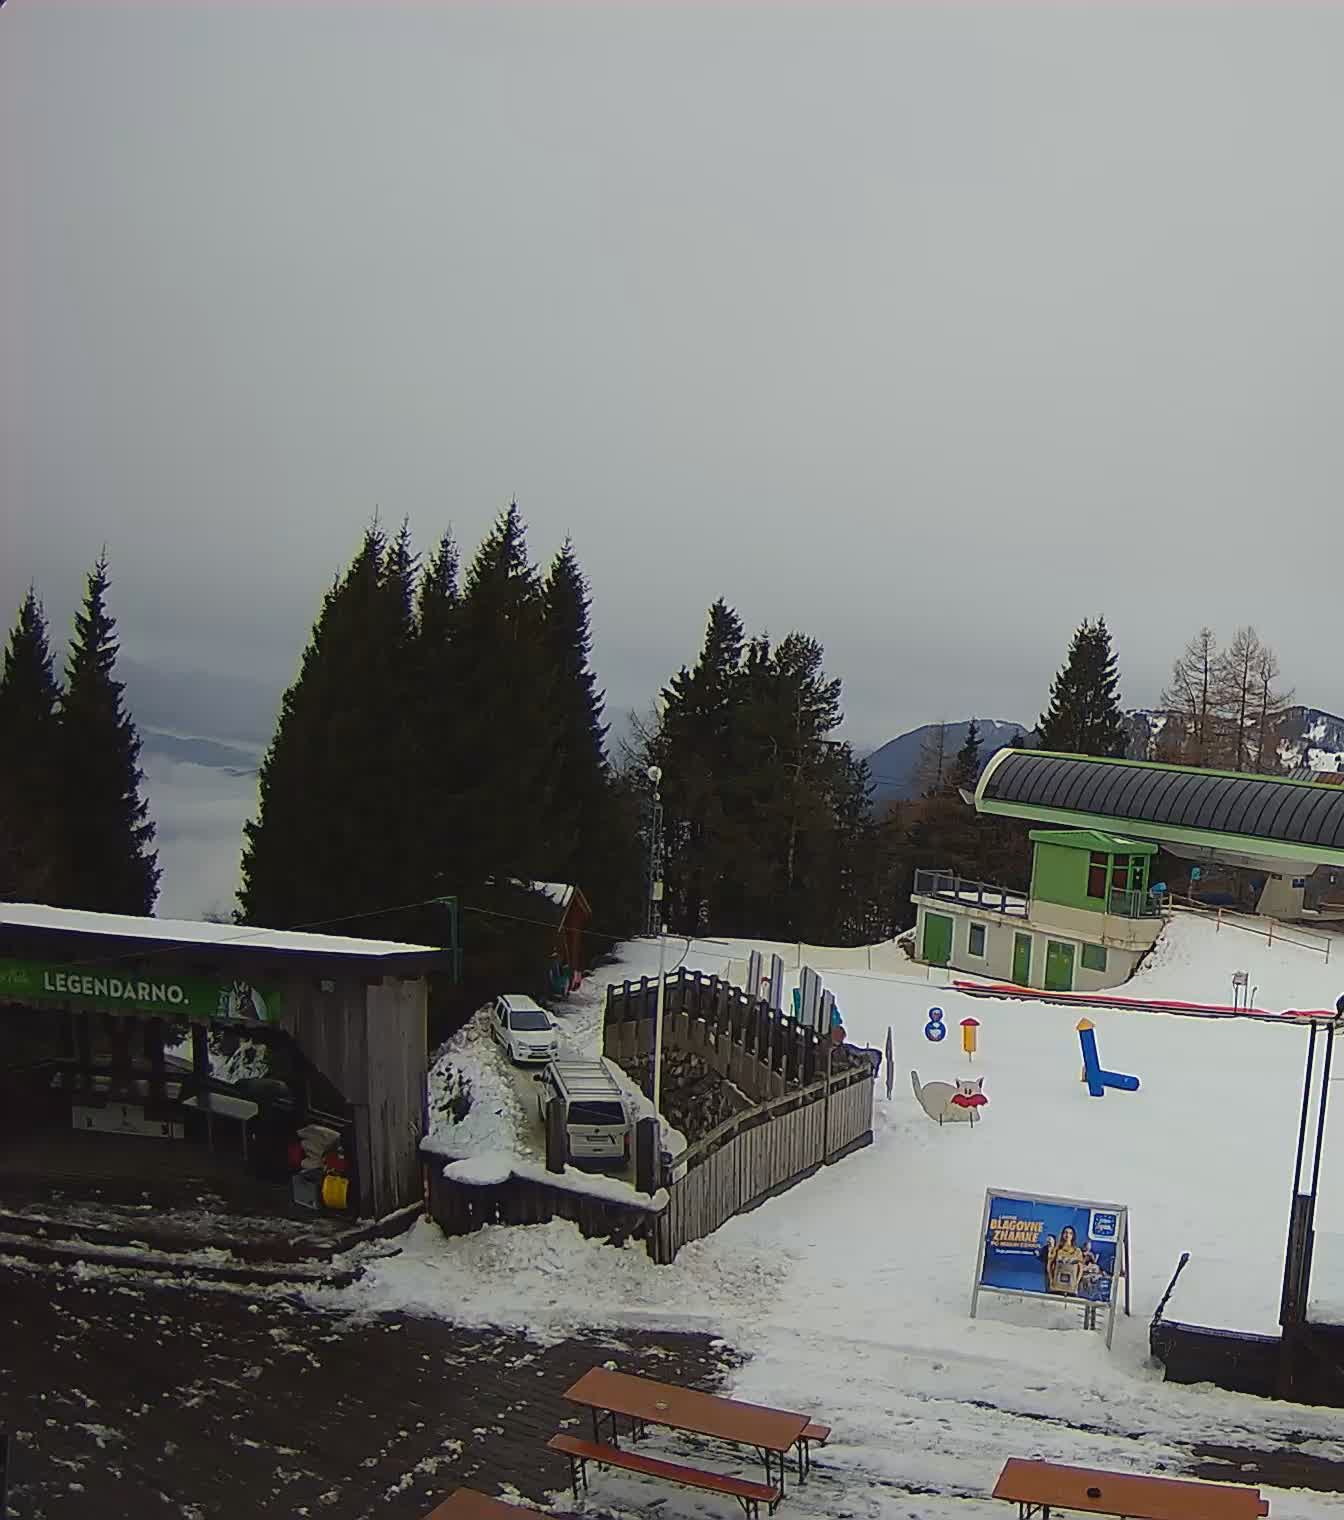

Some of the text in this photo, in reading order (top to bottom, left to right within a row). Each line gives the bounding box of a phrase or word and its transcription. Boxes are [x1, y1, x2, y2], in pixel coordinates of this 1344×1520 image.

[43, 971, 189, 1004] LEGENDARNO.
[990, 1218, 1044, 1233] BLAGOVNE
[992, 1230, 1040, 1244] ZNAMKE
